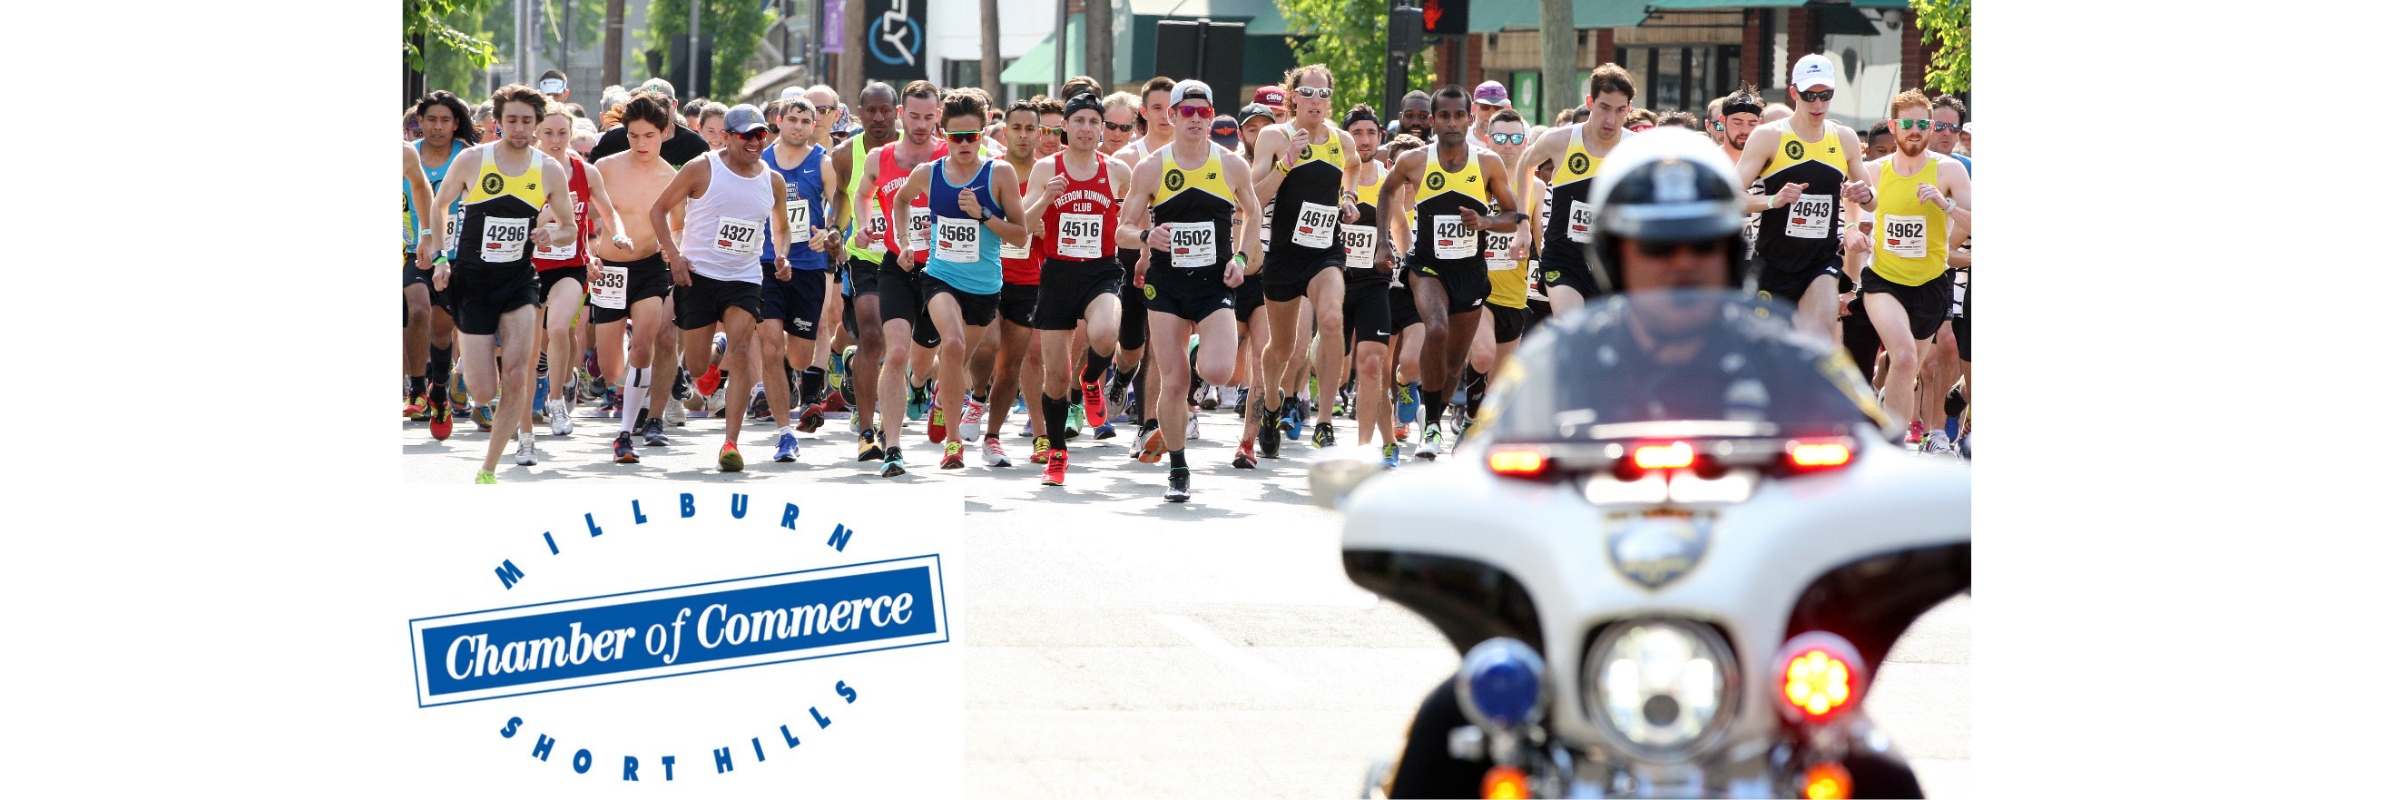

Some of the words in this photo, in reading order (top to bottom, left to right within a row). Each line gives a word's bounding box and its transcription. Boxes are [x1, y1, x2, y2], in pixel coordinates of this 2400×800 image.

[1053, 190, 1082, 209] FREEDOM
[1083, 189, 1111, 208] RUNNING
[1073, 202, 1092, 212] CLUB
[788, 206, 806, 223] 77
[1573, 209, 1593, 225] 43
[1793, 201, 1830, 217] 4643
[1301, 209, 1336, 228] 4619
[486, 225, 526, 241] 4296
[720, 224, 755, 242] 4327
[939, 224, 976, 242] 4568
[1062, 221, 1100, 237] 4516
[1173, 229, 1212, 246] 4502
[1887, 222, 1923, 238] 4962
[1340, 231, 1373, 248] 4931
